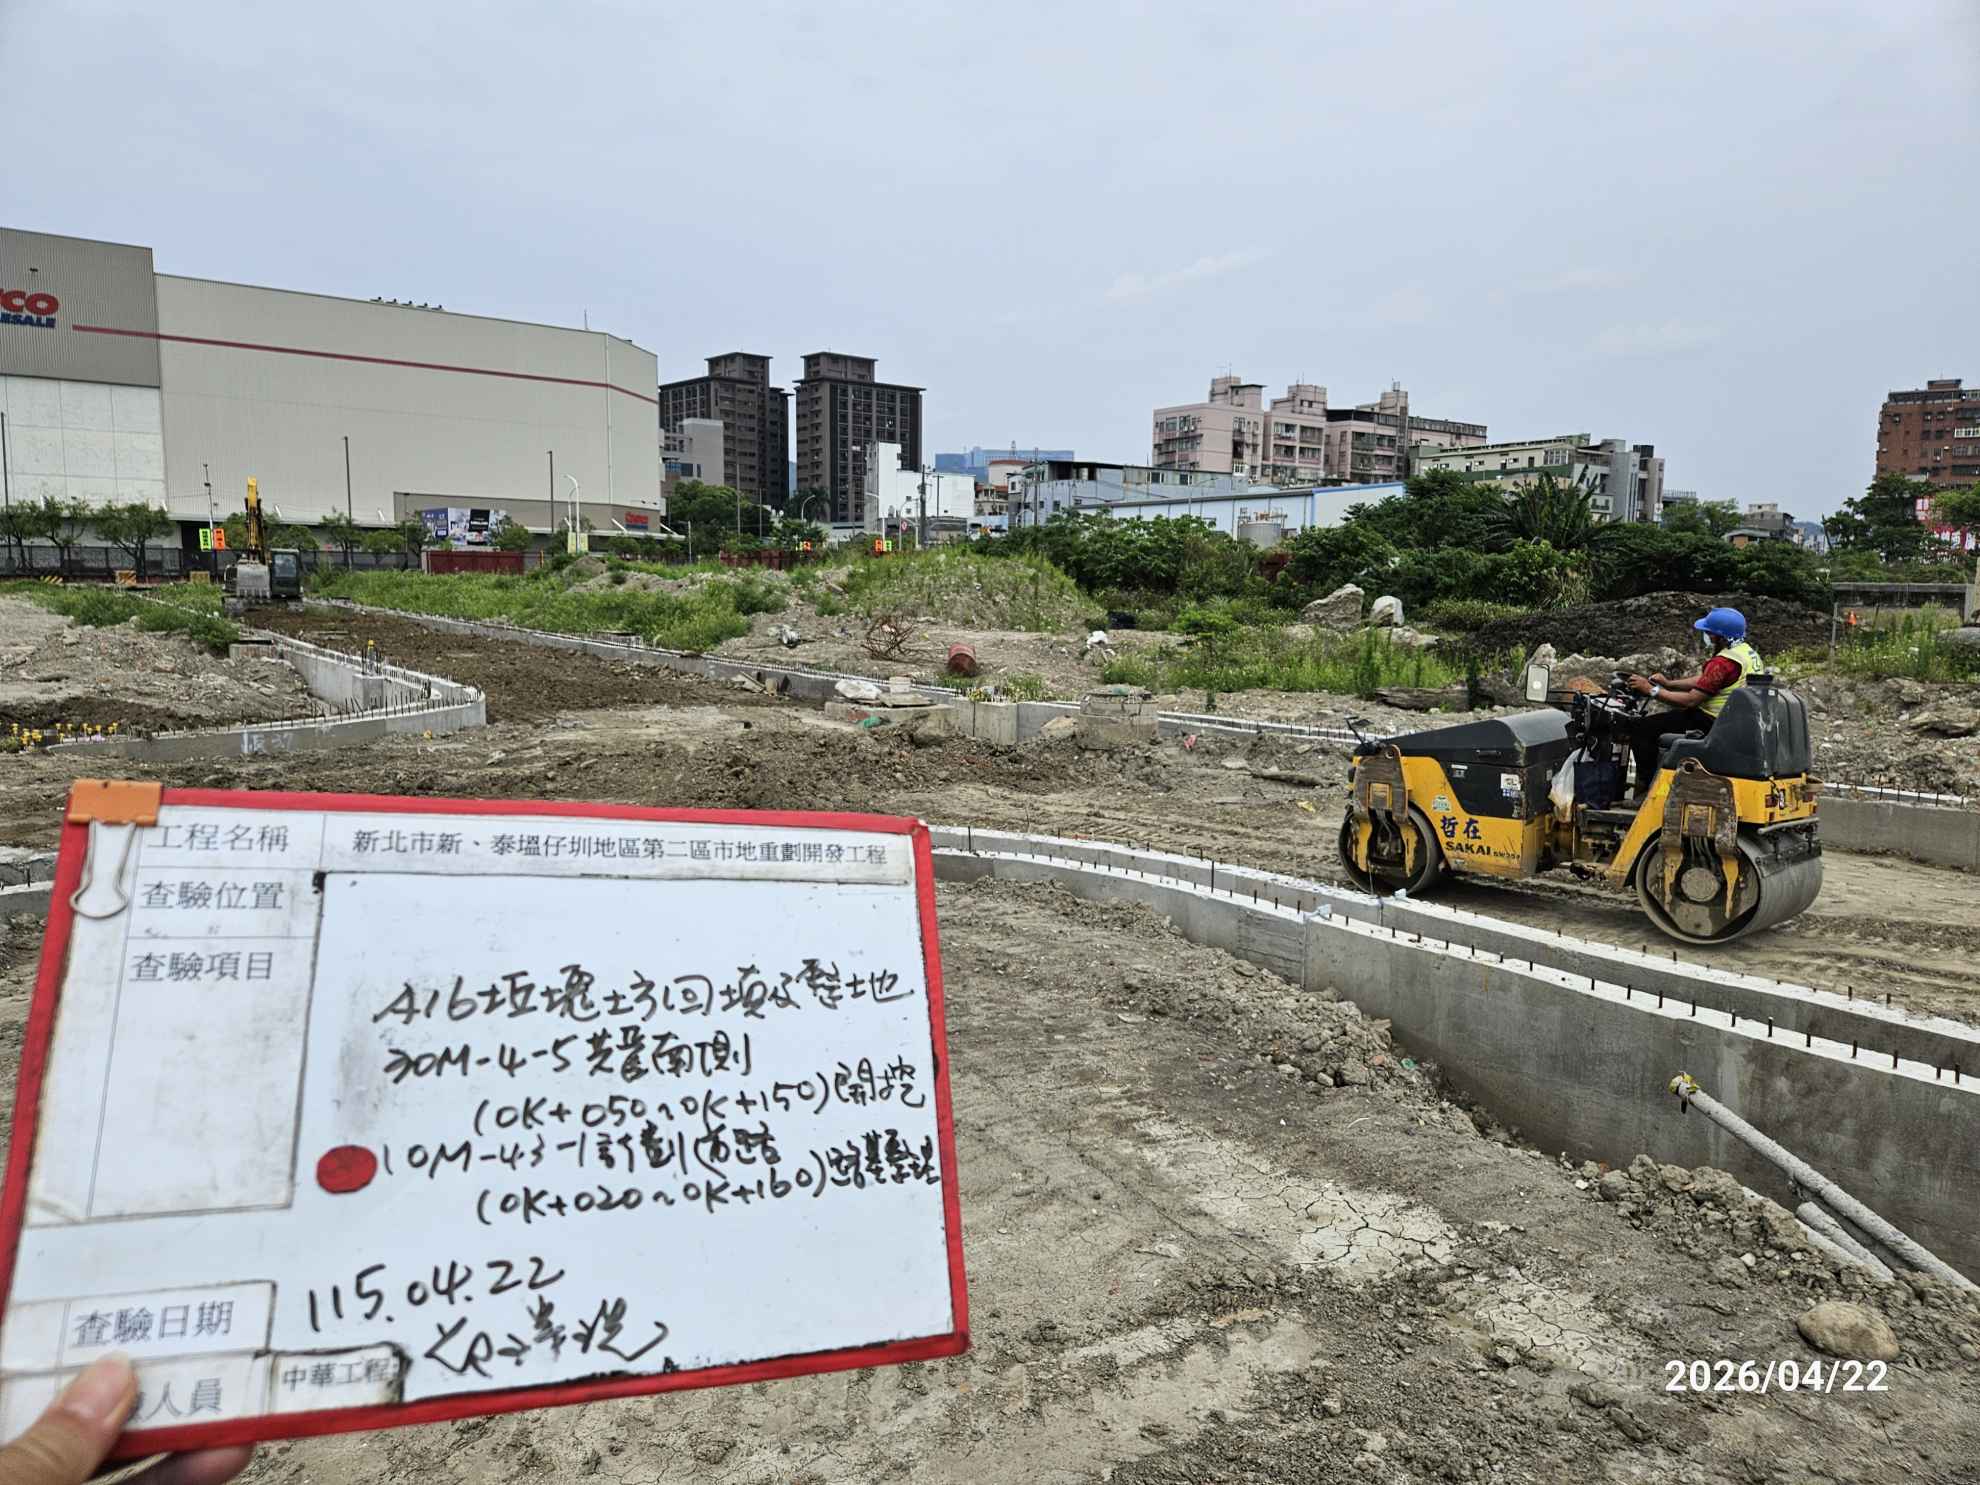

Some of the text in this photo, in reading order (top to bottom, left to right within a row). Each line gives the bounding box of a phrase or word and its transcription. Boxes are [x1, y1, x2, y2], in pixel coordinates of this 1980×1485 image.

[0, 288, 59, 316] CO
[146, 823, 290, 854] 工程名稱
[1445, 841, 1491, 857] SAKAI
[140, 880, 286, 911] 查驗位置
[130, 951, 274, 982] 查驗項目
[308, 1256, 566, 1333] 115.04.22
[69, 1300, 236, 1350] 查驗日期
[129, 1377, 224, 1424] 人員
